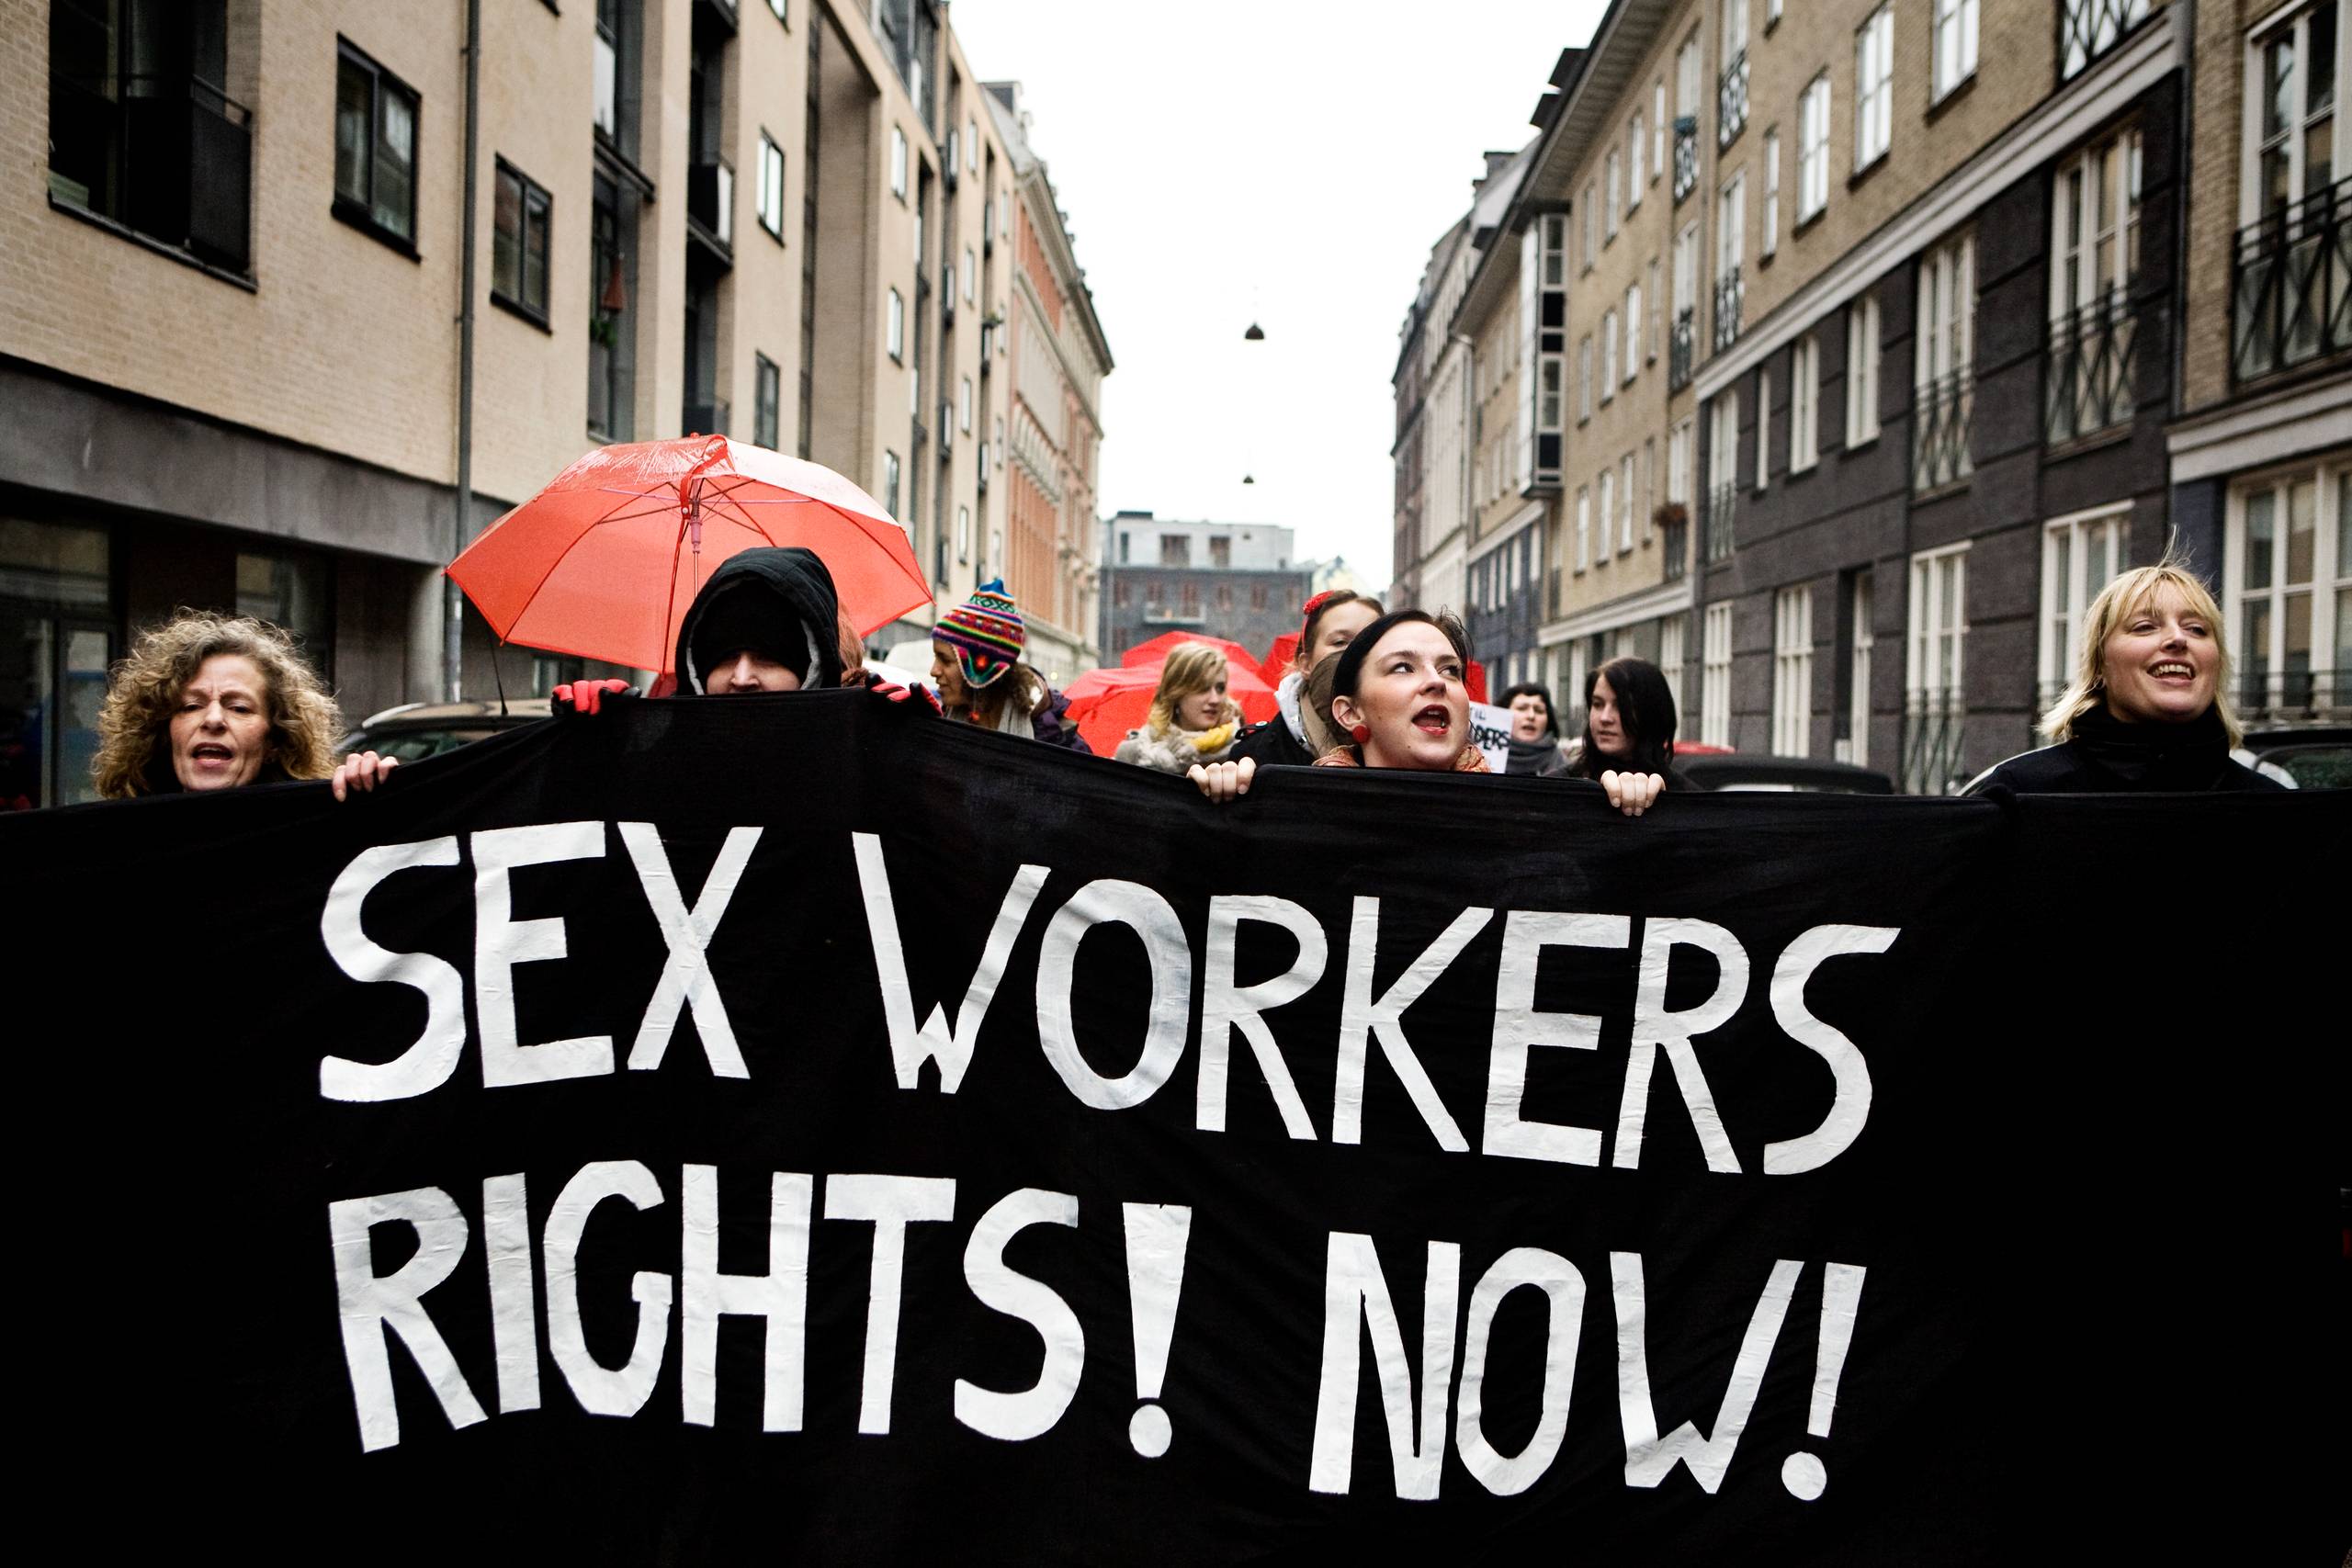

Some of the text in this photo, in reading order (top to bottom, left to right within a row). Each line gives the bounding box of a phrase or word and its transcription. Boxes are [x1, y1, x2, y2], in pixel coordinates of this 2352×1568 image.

[320, 821, 1902, 1177] SEX WORKERS
[329, 1160, 1868, 1501] RIGHTS! NOW!
